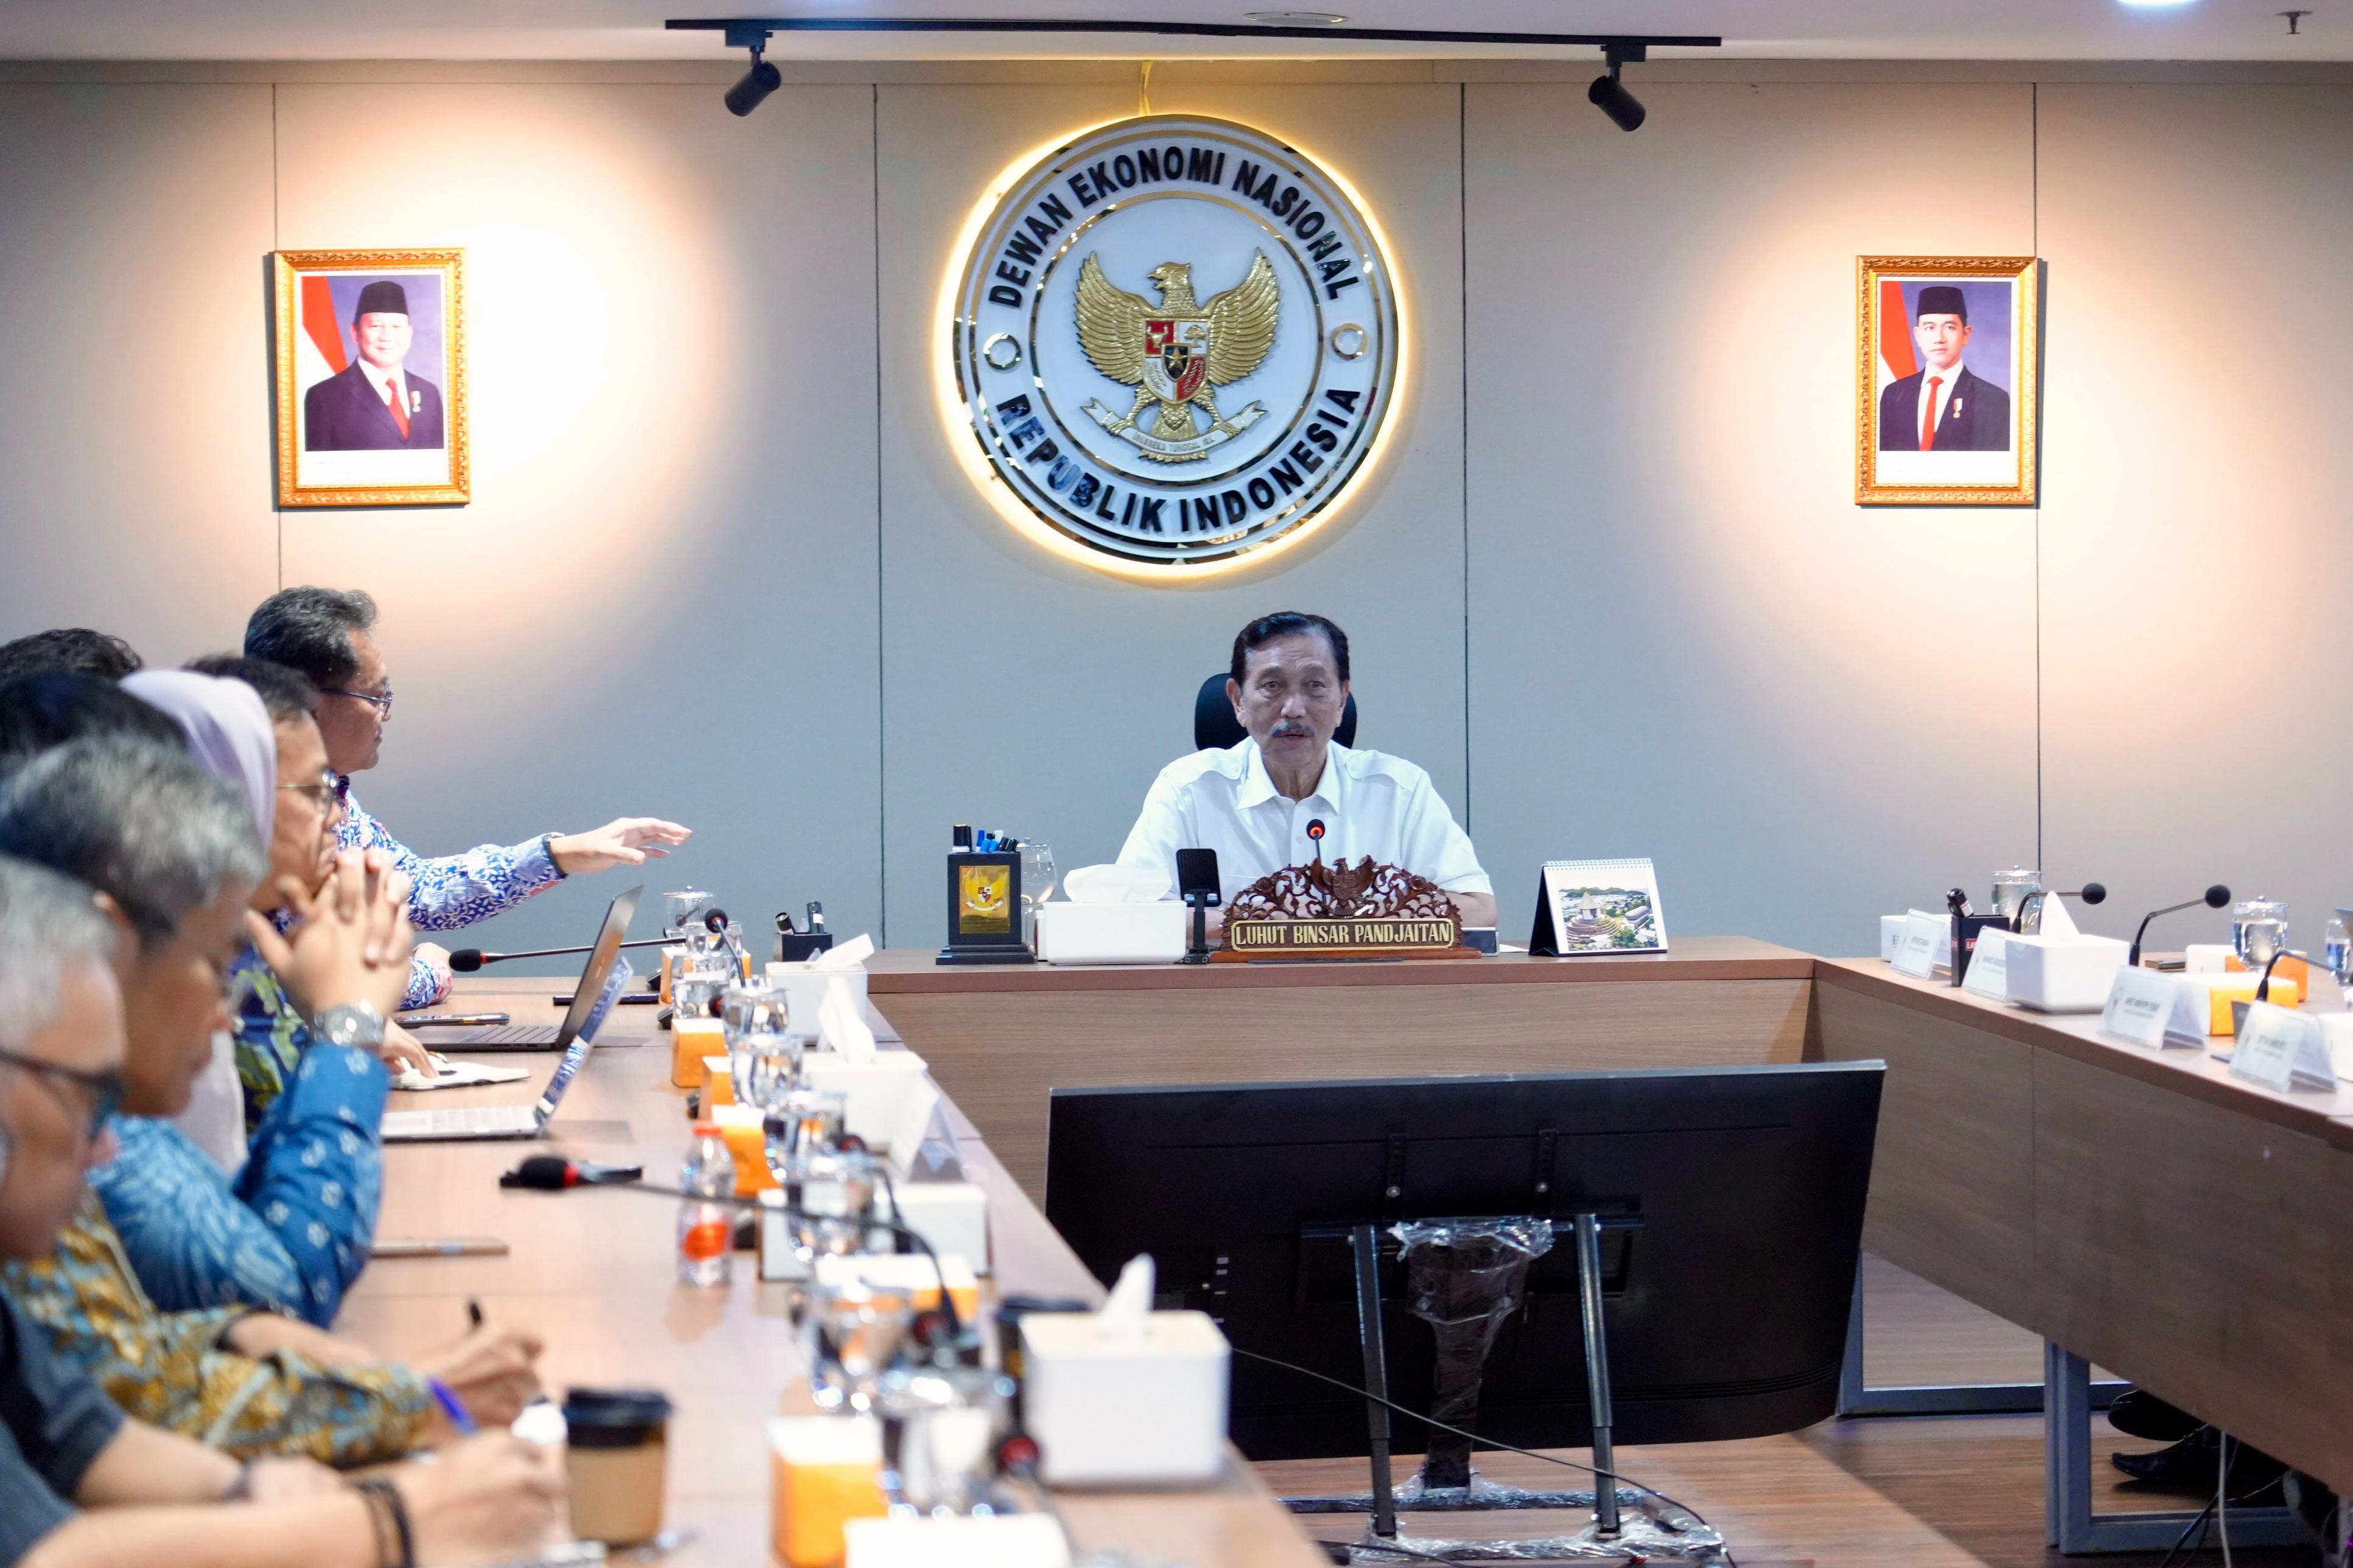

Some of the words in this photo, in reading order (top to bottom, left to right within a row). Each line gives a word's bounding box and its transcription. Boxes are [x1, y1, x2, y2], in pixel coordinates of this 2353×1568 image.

[989, 193, 1072, 308] DEWAN
[1068, 147, 1226, 208] EKONOMI
[1232, 159, 1359, 301] NASIONAL
[996, 394, 1167, 533] REPUBLIK
[1180, 388, 1361, 533] INDONESIA
[1236, 926, 1287, 945] LUHUT
[1293, 925, 1349, 944] BINSAR
[1355, 923, 1450, 943] PANDJAITAN
